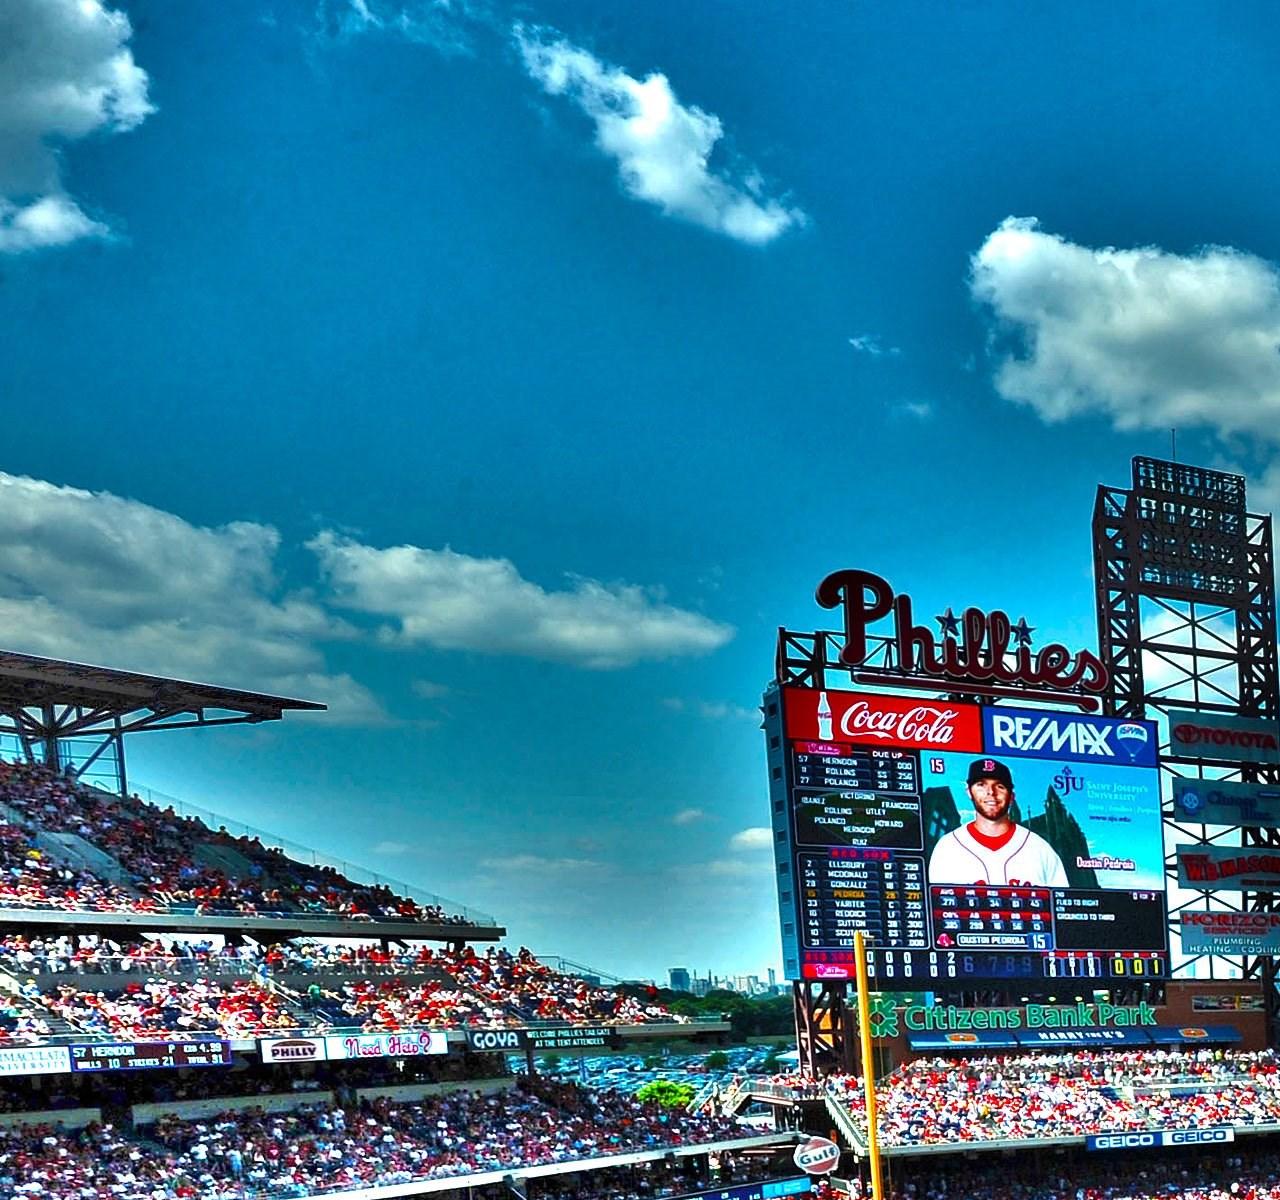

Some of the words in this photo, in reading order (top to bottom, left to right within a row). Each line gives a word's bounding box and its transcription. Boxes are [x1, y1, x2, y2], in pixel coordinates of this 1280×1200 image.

[815, 568, 1109, 691] Phillies
[841, 701, 959, 743] Coca-Cola
[992, 715, 1115, 756] RE/MAX
[1199, 726, 1277, 748] TOYOTA
[930, 758, 944, 772] 15
[1053, 774, 1084, 796] SJU
[1032, 934, 1046, 949] 15
[1213, 937, 1261, 945] PLUMBING
[1189, 945, 1231, 953] HEATING
[947, 952, 955, 964] 2
[963, 956, 973, 972] 6
[1115, 959, 1124, 974] 0
[1134, 959, 1143, 974] 0
[1153, 959, 1159, 974] 1
[904, 1006, 1021, 1030] Citizens
[1026, 1003, 1095, 1028] Bank
[1099, 1001, 1157, 1026] Park
[344, 1036, 382, 1057] Need
[472, 1031, 520, 1050] GOYA
[168, 1045, 175, 1053] P
[108, 1058, 120, 1068] 10
[162, 1057, 174, 1066] 21
[211, 1054, 223, 1064] 31
[1095, 1133, 1154, 1148] GEICO
[1171, 1129, 1227, 1144] GEICO
[800, 1147, 837, 1165] Gulf
